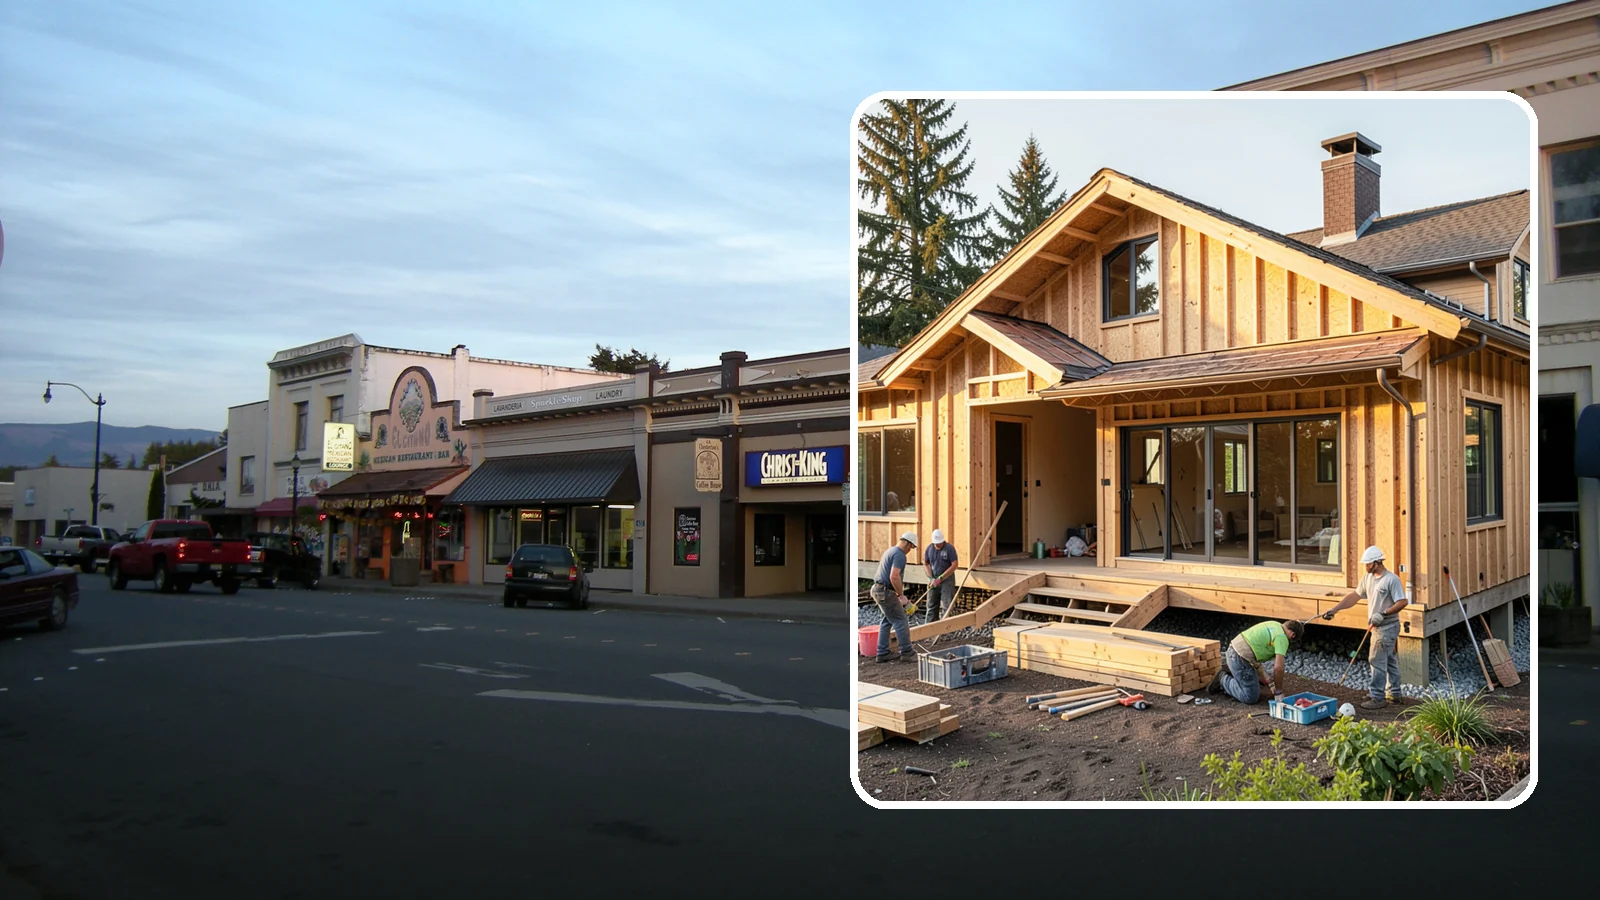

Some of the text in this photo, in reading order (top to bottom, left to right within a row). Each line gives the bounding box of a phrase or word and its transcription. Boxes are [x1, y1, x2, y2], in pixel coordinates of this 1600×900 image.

[595, 388, 624, 400] LAUNDRY
[493, 402, 523, 412] LAVANDERIA
[531, 394, 583, 409] Sparkle Shop
[373, 454, 396, 464] MEXICAN
[397, 451, 433, 462] RESTAURANT
[438, 450, 450, 459] BAR
[761, 450, 827, 477] CHRIST KING
[710, 481, 722, 489] House
